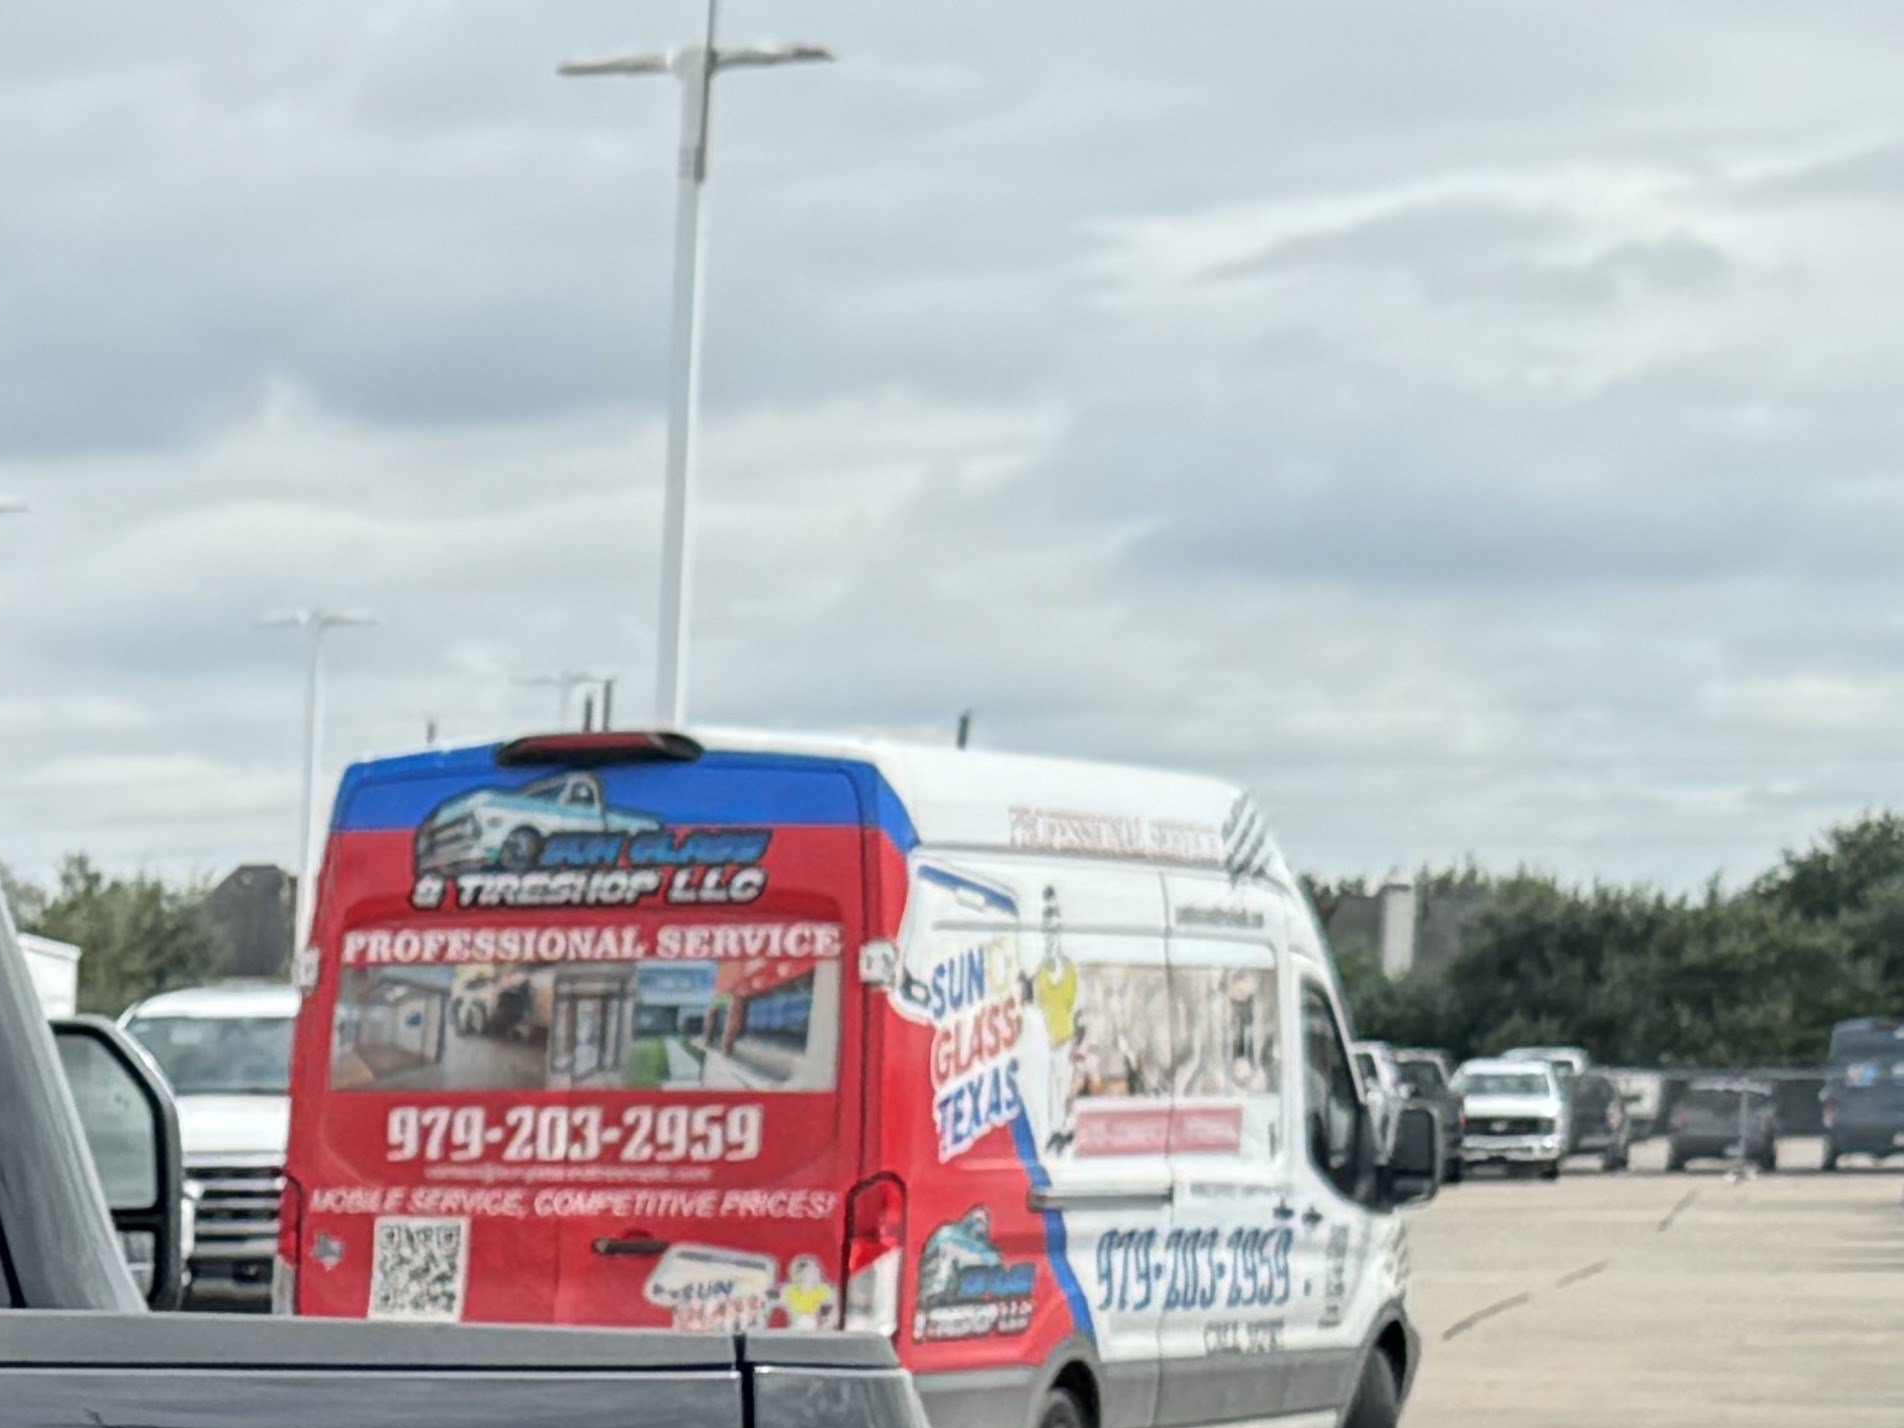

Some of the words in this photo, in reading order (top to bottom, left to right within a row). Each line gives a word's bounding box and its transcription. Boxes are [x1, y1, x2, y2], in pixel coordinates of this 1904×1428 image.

[457, 871, 661, 906] TIRESHOP
[666, 868, 767, 904] LLC
[343, 926, 643, 963] PROFESSIONAL
[657, 922, 844, 958] SERVICE
[932, 944, 986, 1020] SUN
[935, 995, 1023, 1083] GLASS
[386, 1104, 764, 1162] 979-203-2959
[938, 1058, 1021, 1152] TEXAS
